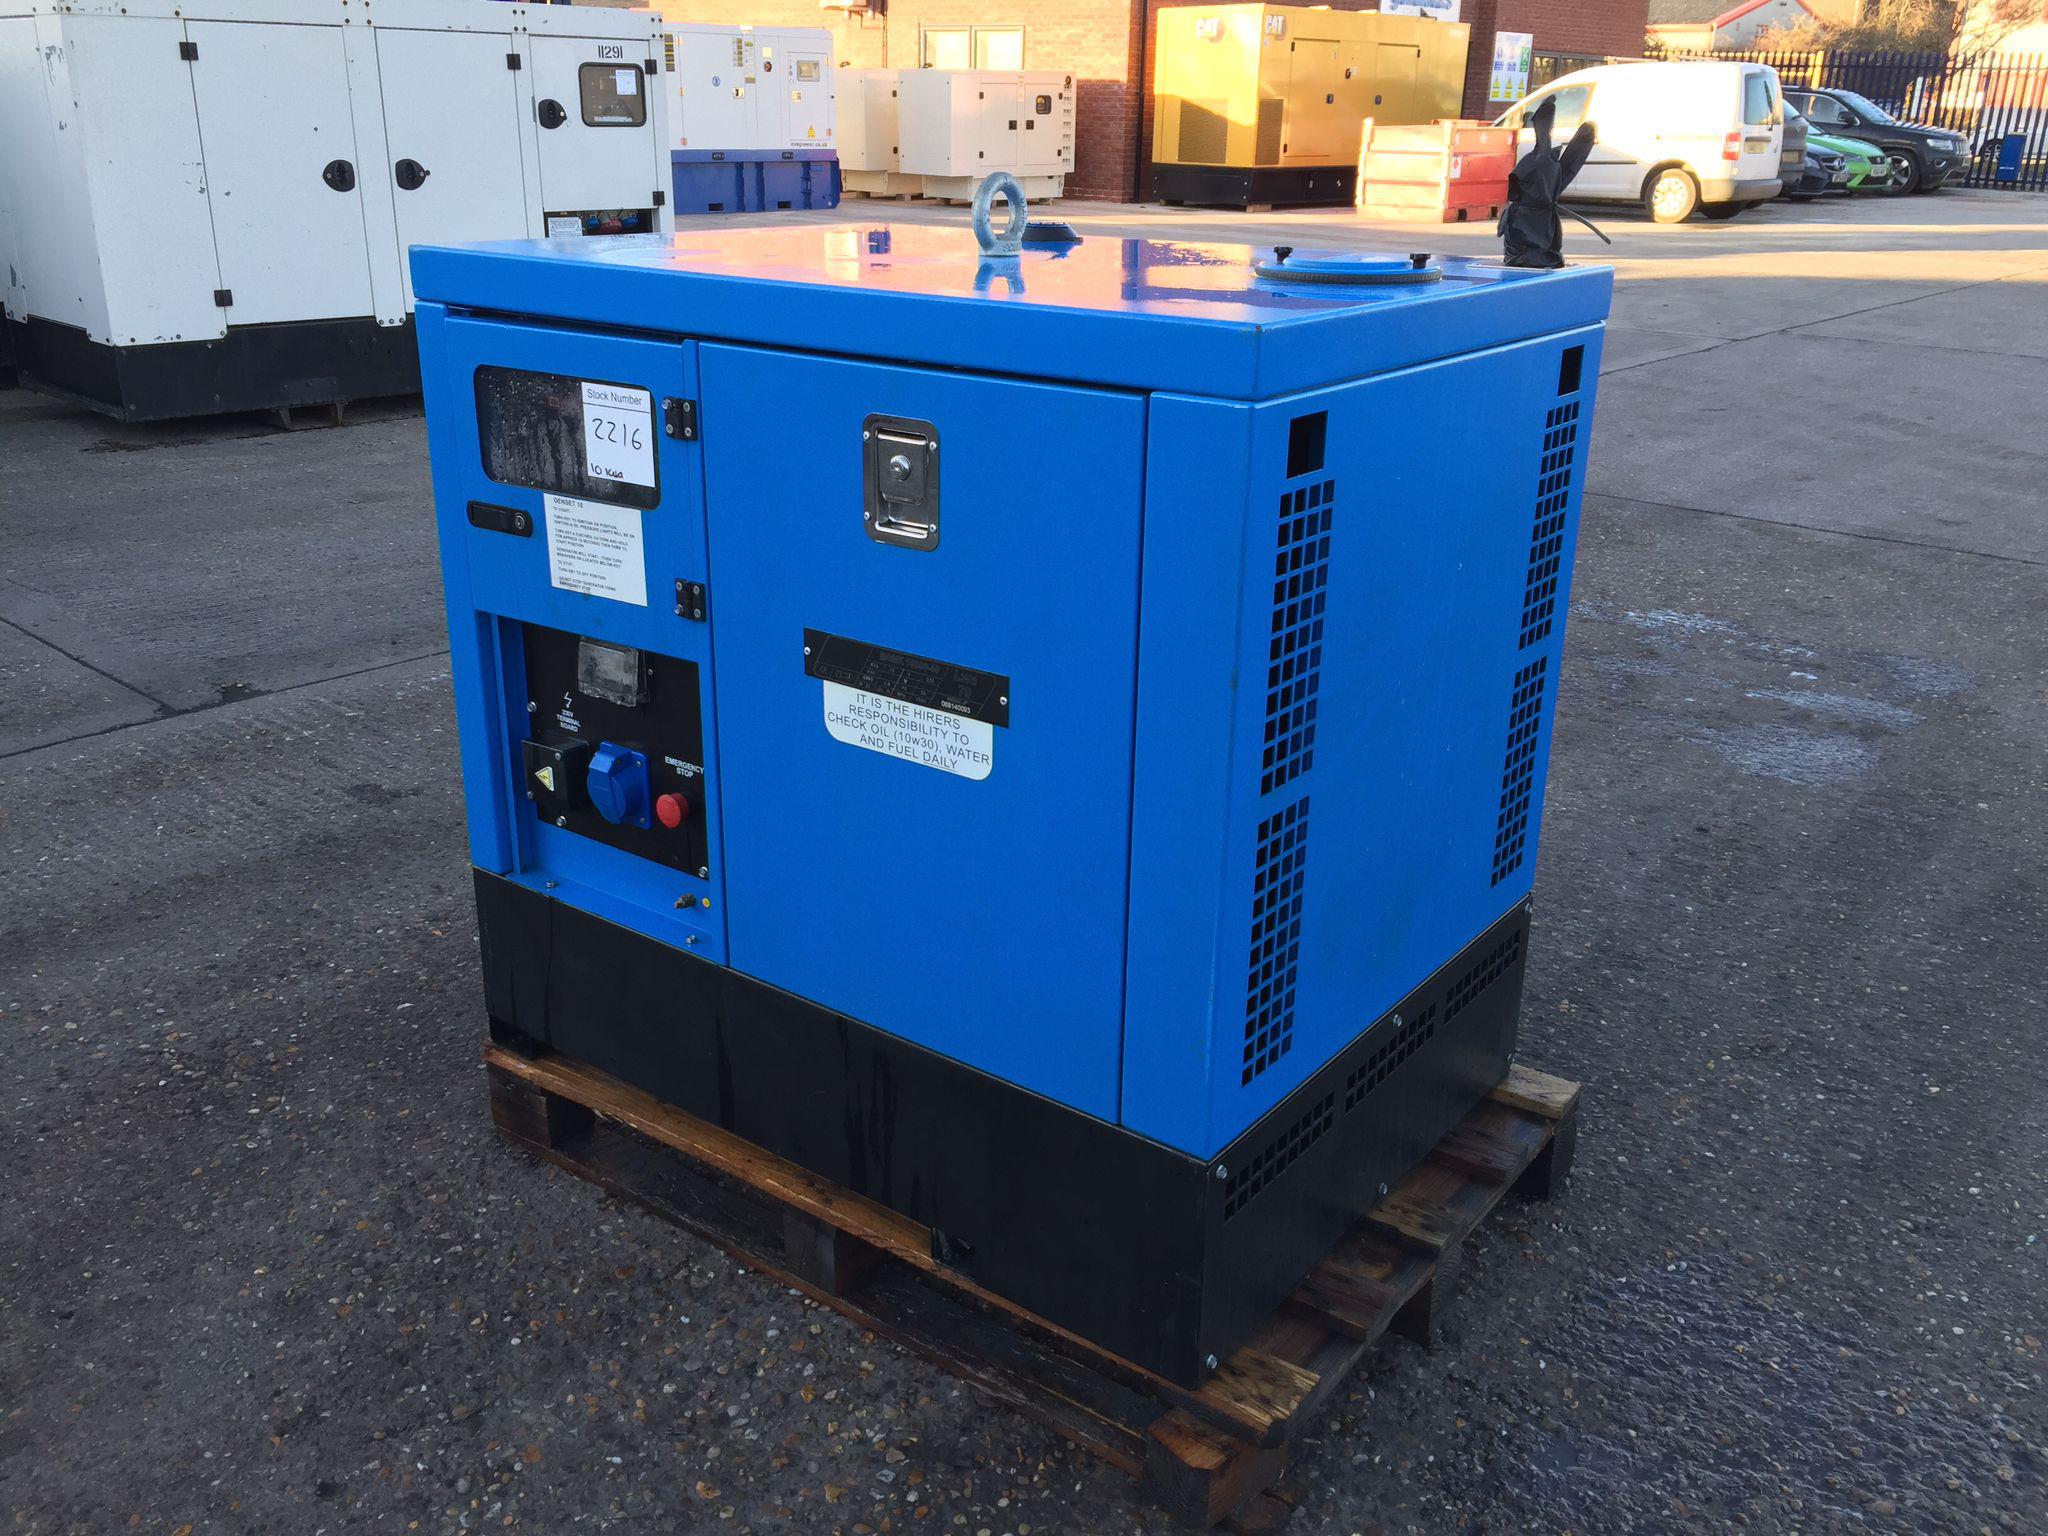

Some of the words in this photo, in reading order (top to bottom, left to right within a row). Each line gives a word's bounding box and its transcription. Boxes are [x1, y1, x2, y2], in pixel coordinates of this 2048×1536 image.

[1197, 18, 1219, 38] CAT
[1266, 14, 1284, 34] CAT
[598, 45, 623, 58] 11291
[587, 389, 608, 399] Stock
[611, 392, 642, 405] Number
[592, 418, 642, 450] 2216
[591, 463, 602, 474] 10
[857, 694, 867, 704] IT
[872, 697, 882, 708] IS
[886, 701, 910, 716] THE
[914, 708, 960, 729] HIRERS
[849, 704, 948, 739] RESPONSIBILITY
[953, 732, 969, 745] TO
[828, 712, 867, 731] CHECK
[871, 724, 889, 738] OIL
[946, 745, 990, 765] WATER
[860, 734, 884, 748] AND
[888, 742, 918, 759] FUEL
[923, 751, 958, 769] DAILY
[664, 756, 704, 774] EMERGENCY
[676, 767, 693, 778] STOP
